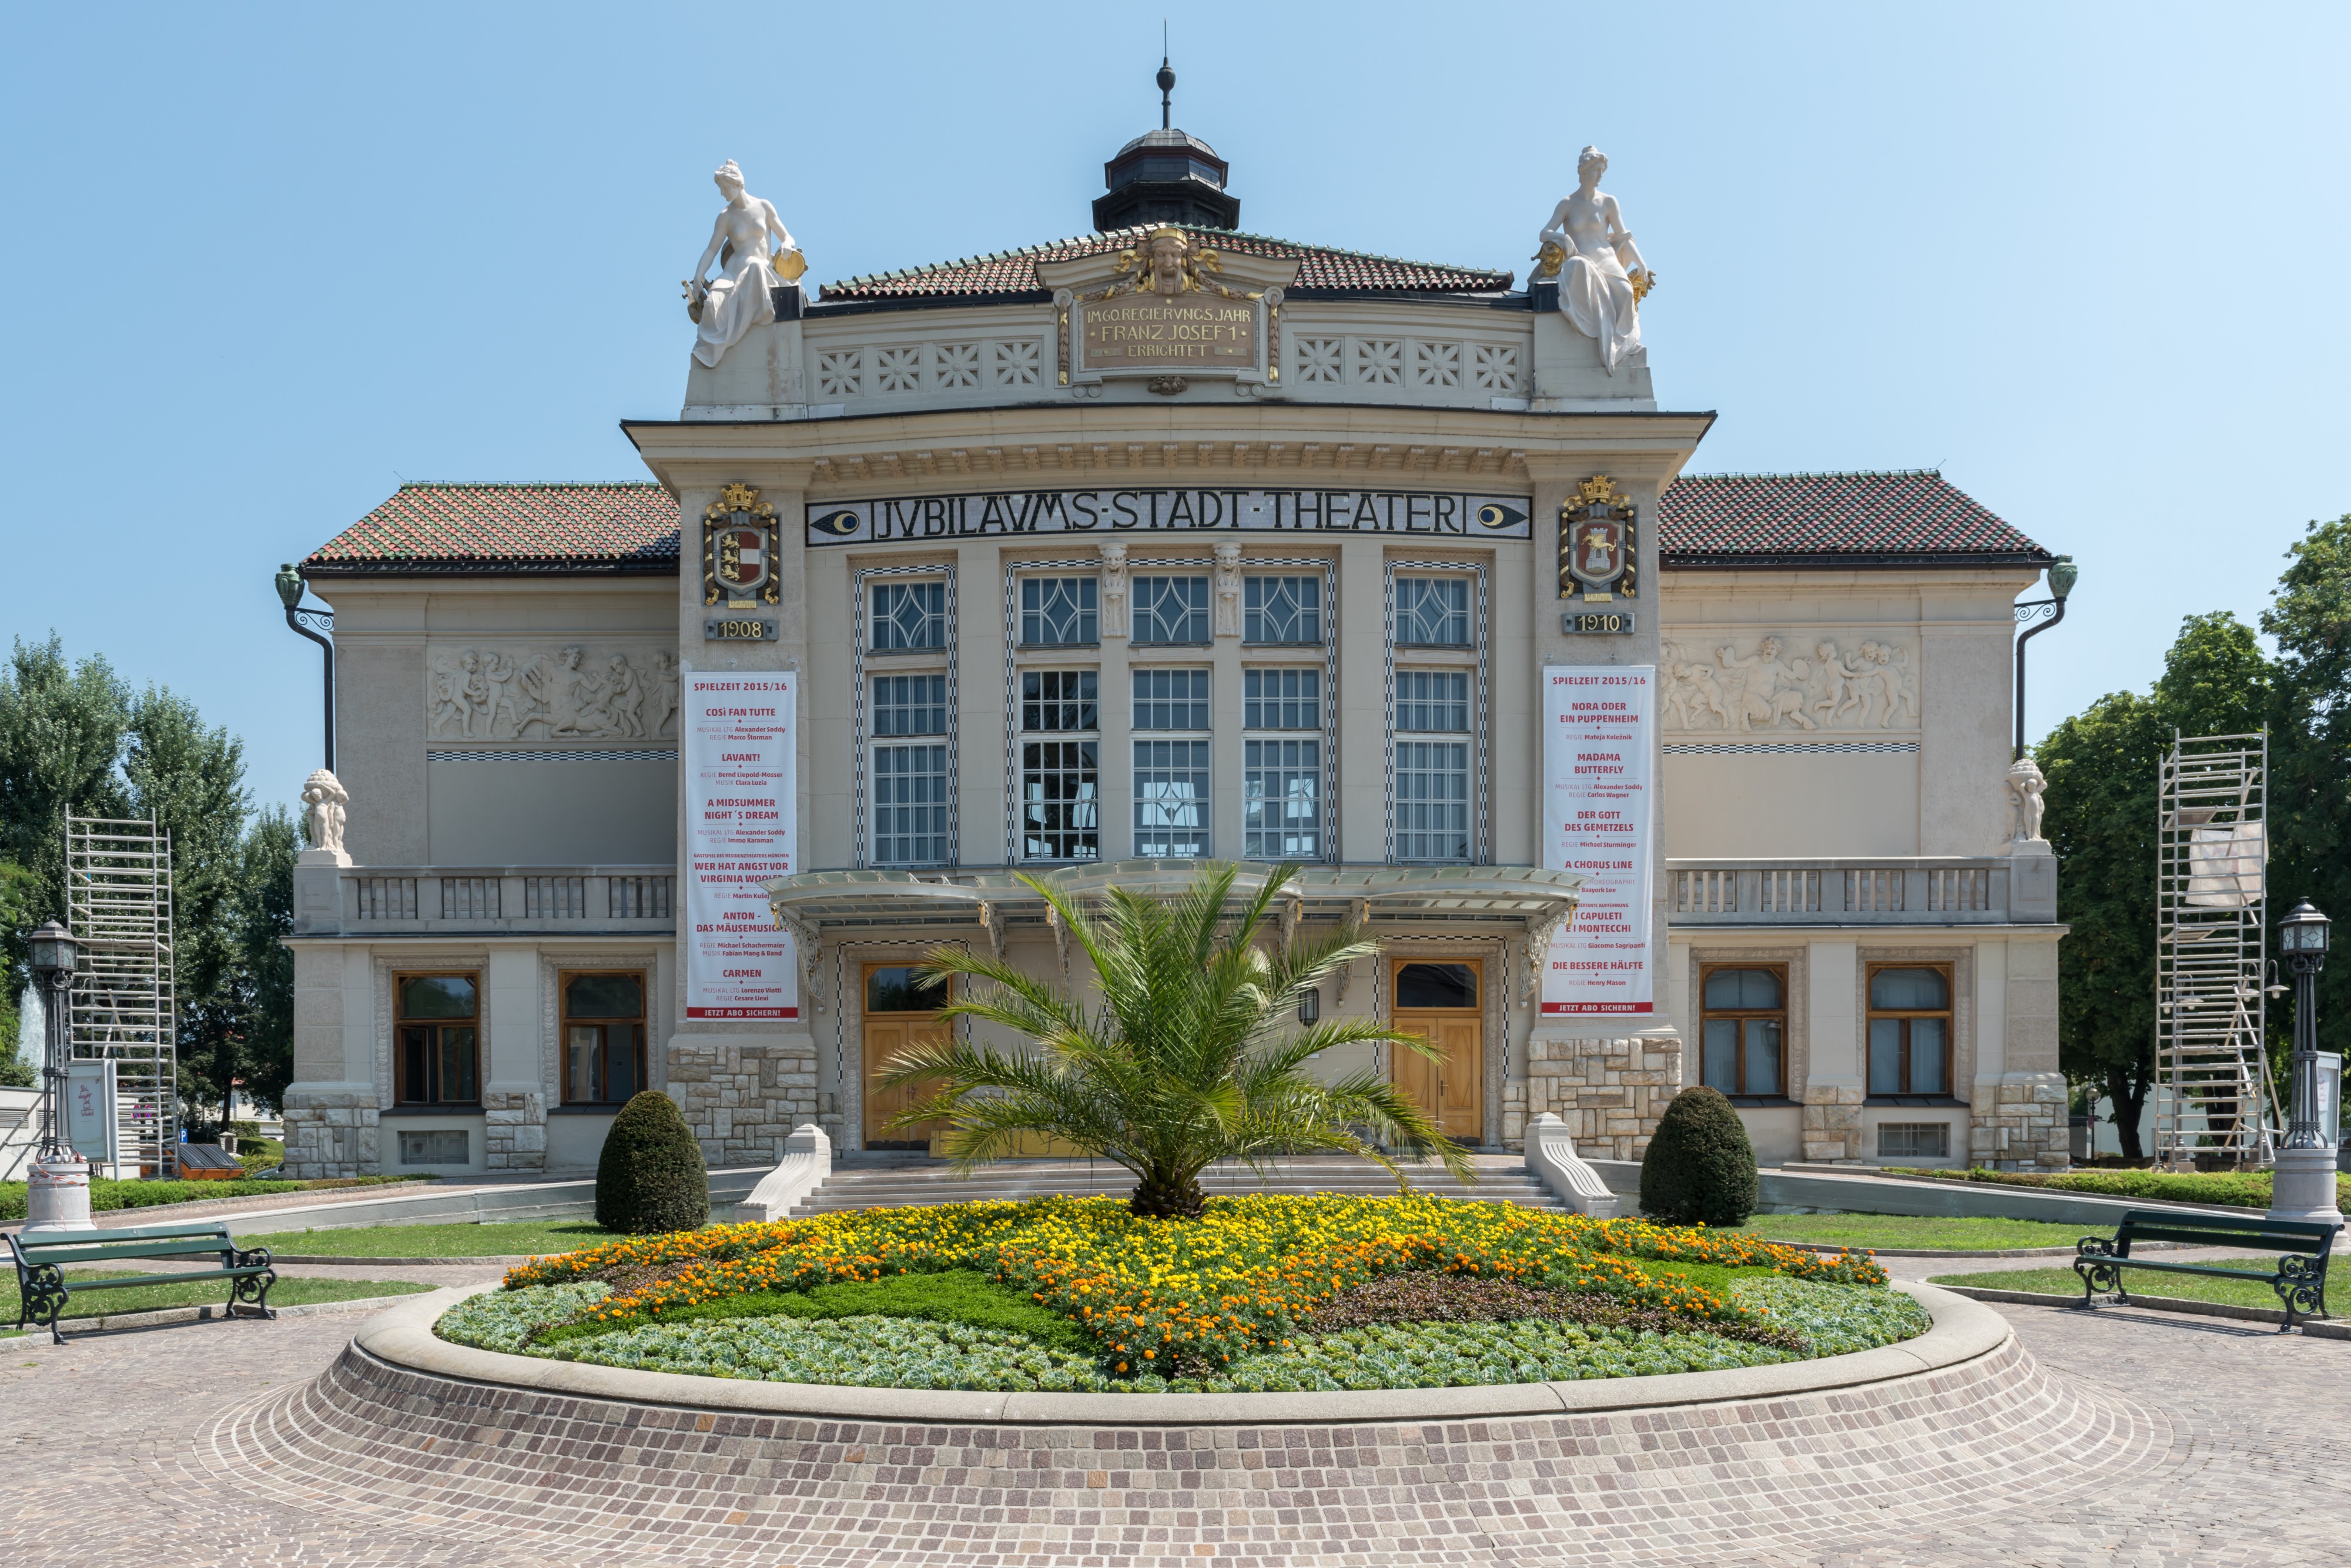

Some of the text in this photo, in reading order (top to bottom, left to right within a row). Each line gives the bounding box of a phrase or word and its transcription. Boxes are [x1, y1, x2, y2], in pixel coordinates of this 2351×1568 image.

[1087, 310, 1101, 323] IM
[1215, 309, 1250, 323] JAHR
[1101, 324, 1163, 342] FRANZ
[1168, 324, 1225, 341] JOSEF
[1128, 344, 1207, 357] ERRICHTET
[1112, 491, 1249, 529] STADT
[1264, 491, 1460, 533] THEATER
[1578, 614, 1620, 631] 1910
[720, 621, 762, 638] 1908
[1602, 676, 1646, 686] 2015/16
[694, 682, 788, 692] SPIELZEIT 2015/16
[1572, 702, 1626, 711] NORA ODER
[728, 708, 746, 716] FAN
[748, 708, 776, 716] TUTTE
[1560, 715, 1639, 723] EIN PUPPENHEIM
[722, 753, 761, 762] LAVANT!
[1577, 753, 1621, 762] MADAMA
[1574, 766, 1624, 774] BUTTERFLY
[745, 811, 779, 819] DREAM
[1578, 811, 1621, 819] DER GOTT
[1565, 823, 1634, 832] DES GEMETZELS
[695, 862, 789, 870] WER HAT ANGST VOR
[1565, 860, 1633, 869] A CHORUS LINE
[700, 875, 744, 883] VIRGINIA
[723, 912, 755, 920] ANTON
[1580, 912, 1622, 920] CAPULETI
[716, 922, 788, 932] MÄUSEMUSICL
[1578, 924, 1631, 933] MONTECCHI
[1552, 960, 1643, 970] DIE BESSERE HÄLFTE
[722, 969, 762, 977] CARMEN
